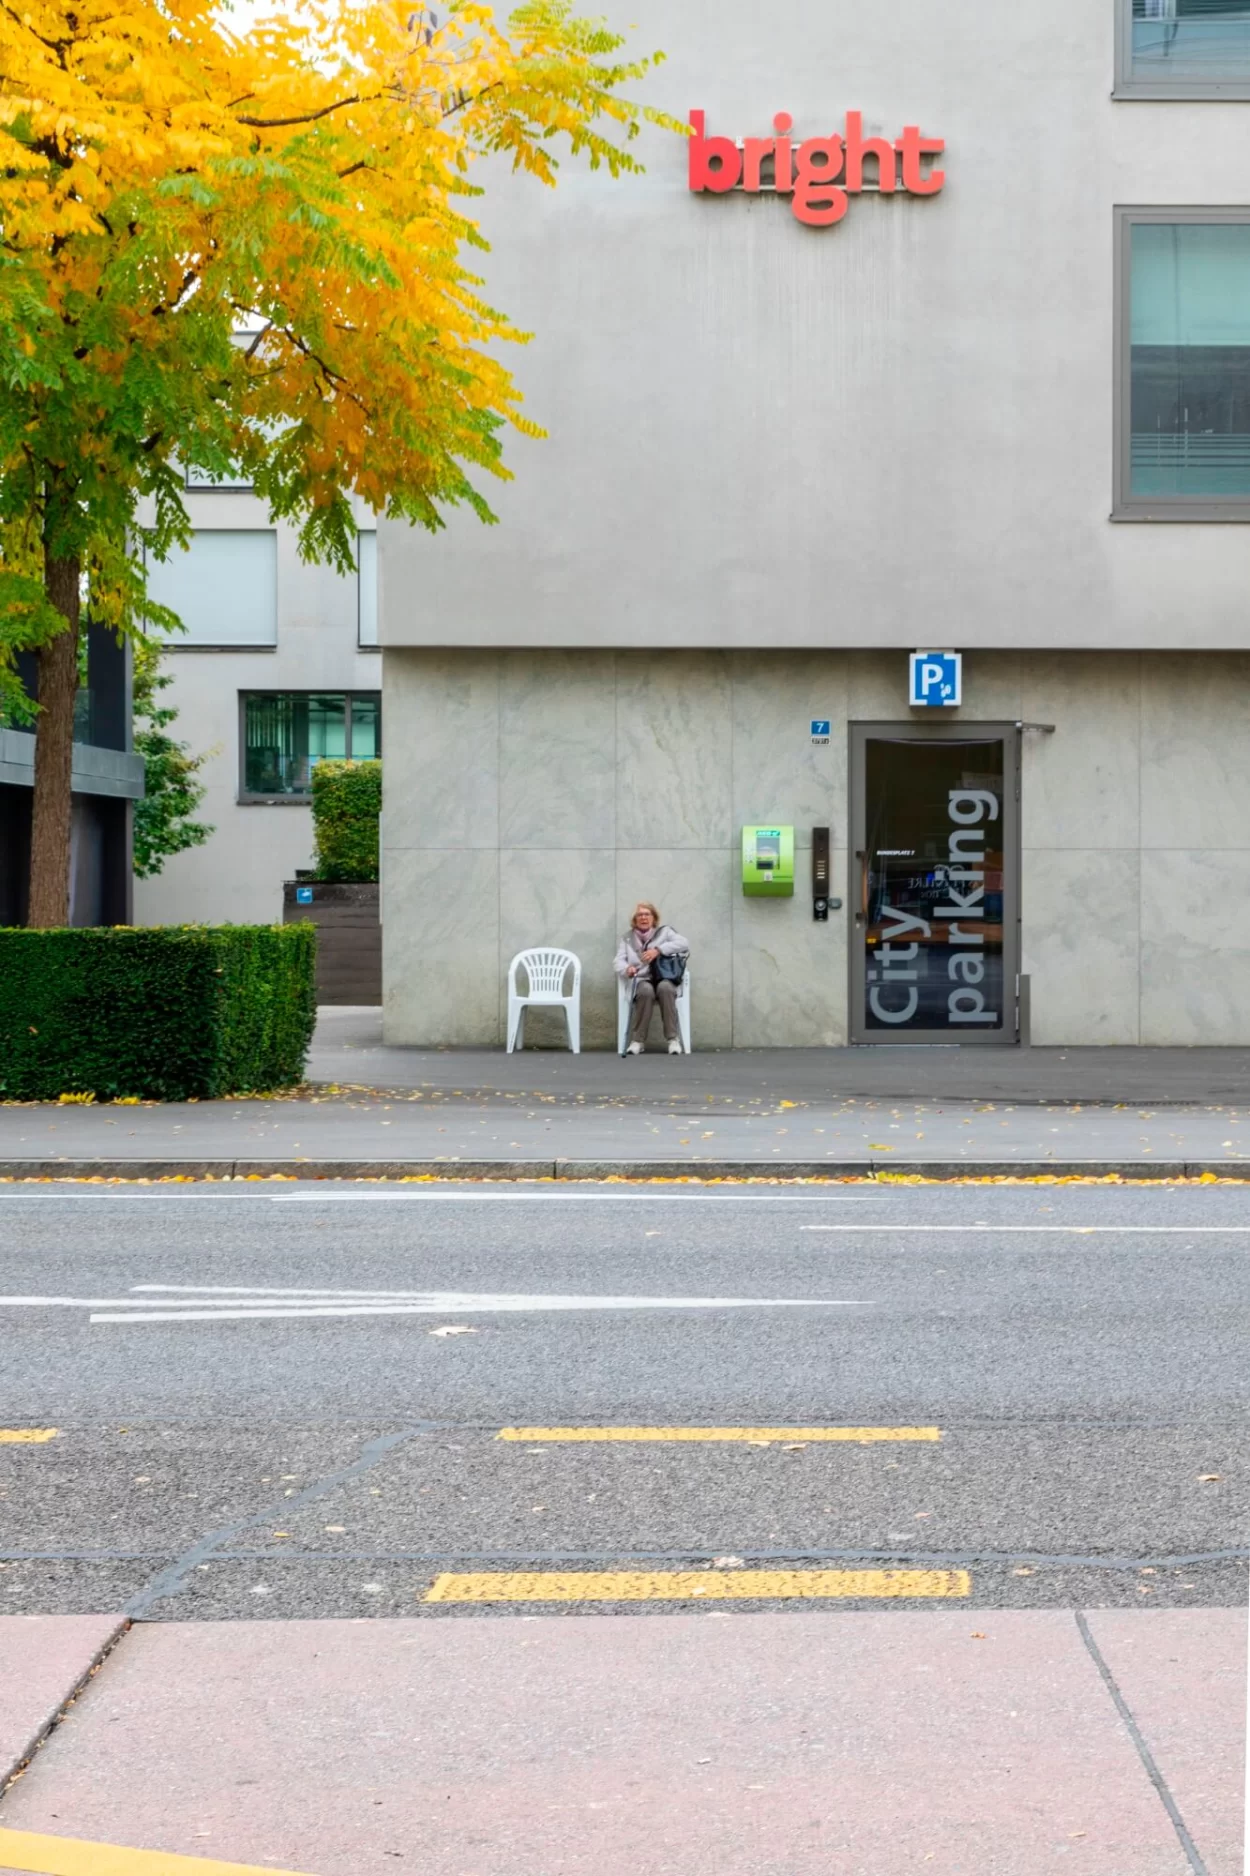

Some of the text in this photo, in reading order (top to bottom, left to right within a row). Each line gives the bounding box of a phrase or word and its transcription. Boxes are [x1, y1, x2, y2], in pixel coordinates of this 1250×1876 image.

[689, 109, 945, 226] bright
[816, 722, 825, 733] 7
[922, 663, 944, 696] P
[867, 905, 931, 1023] City
[933, 790, 999, 1022] parking
